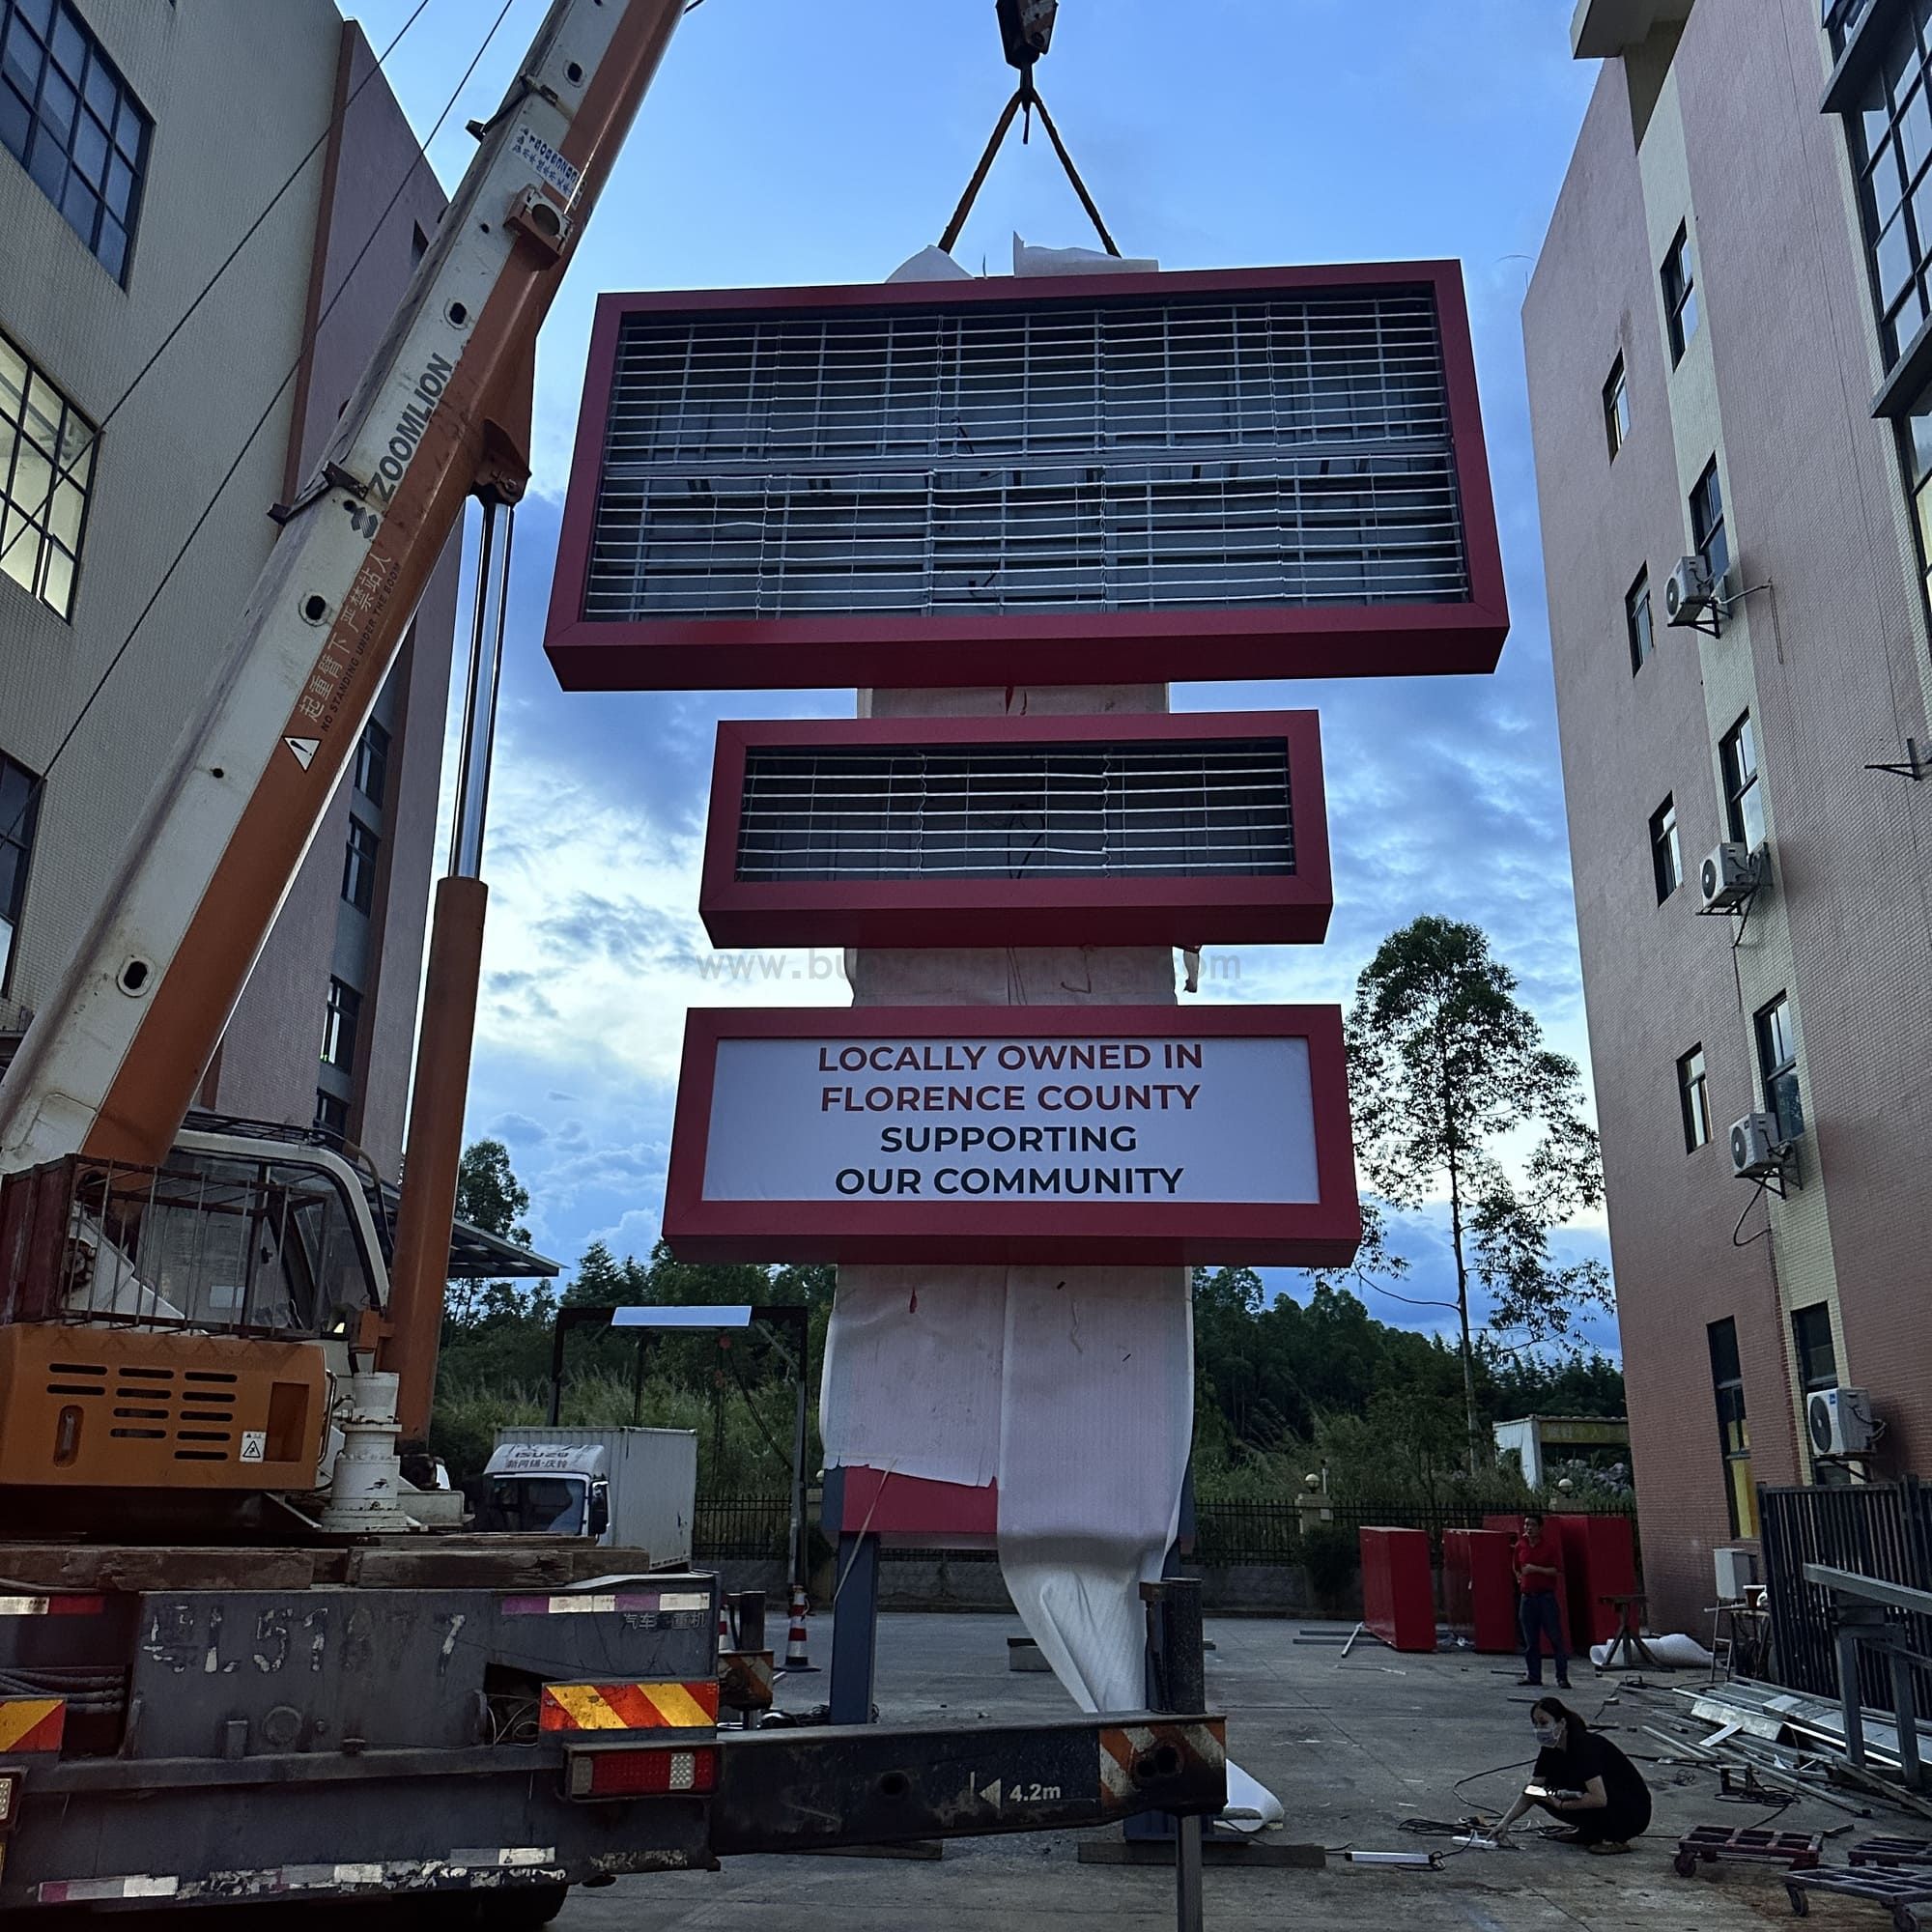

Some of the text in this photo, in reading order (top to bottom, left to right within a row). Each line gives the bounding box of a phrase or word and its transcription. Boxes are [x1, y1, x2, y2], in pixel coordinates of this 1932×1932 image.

[369, 353, 453, 503] ZOOMLION
[298, 552, 393, 722] 起重臂下 严禁站人
[320, 560, 403, 732] NO STANDING UNDER THE BOOM
[818, 1042, 1203, 1072] LOCALLY OWNED IN
[821, 1082, 1201, 1113] FLORENCE COUNTY
[880, 1125, 1137, 1153] SUPPORTING
[836, 1167, 1184, 1196] OUR COMMUNITY
[623, 1612, 706, 1630] 汽车重机
[1009, 1784, 1061, 1803] 4.2m
